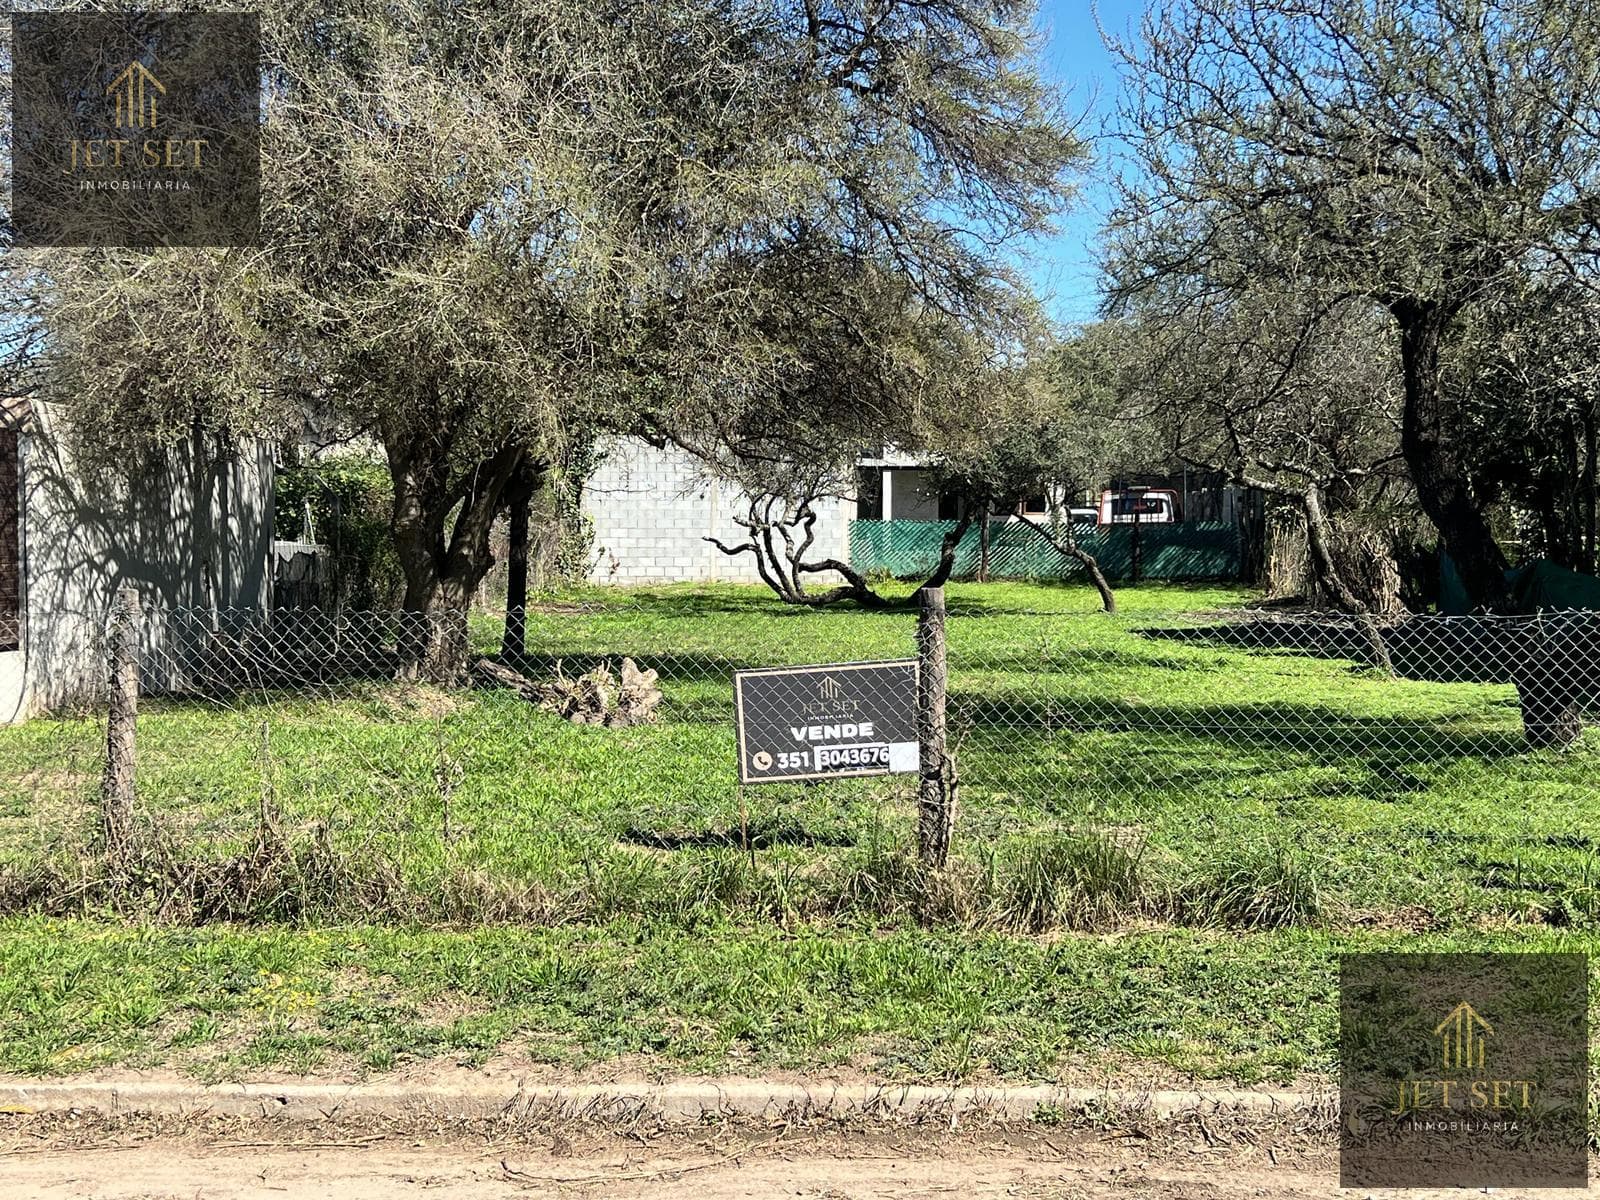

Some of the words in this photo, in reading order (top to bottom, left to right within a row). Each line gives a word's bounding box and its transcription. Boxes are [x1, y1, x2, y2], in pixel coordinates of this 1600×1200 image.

[832, 699, 861, 712] SET
[791, 722, 874, 741] VENDE
[777, 751, 809, 769] 351
[820, 747, 890, 766] 3043676
